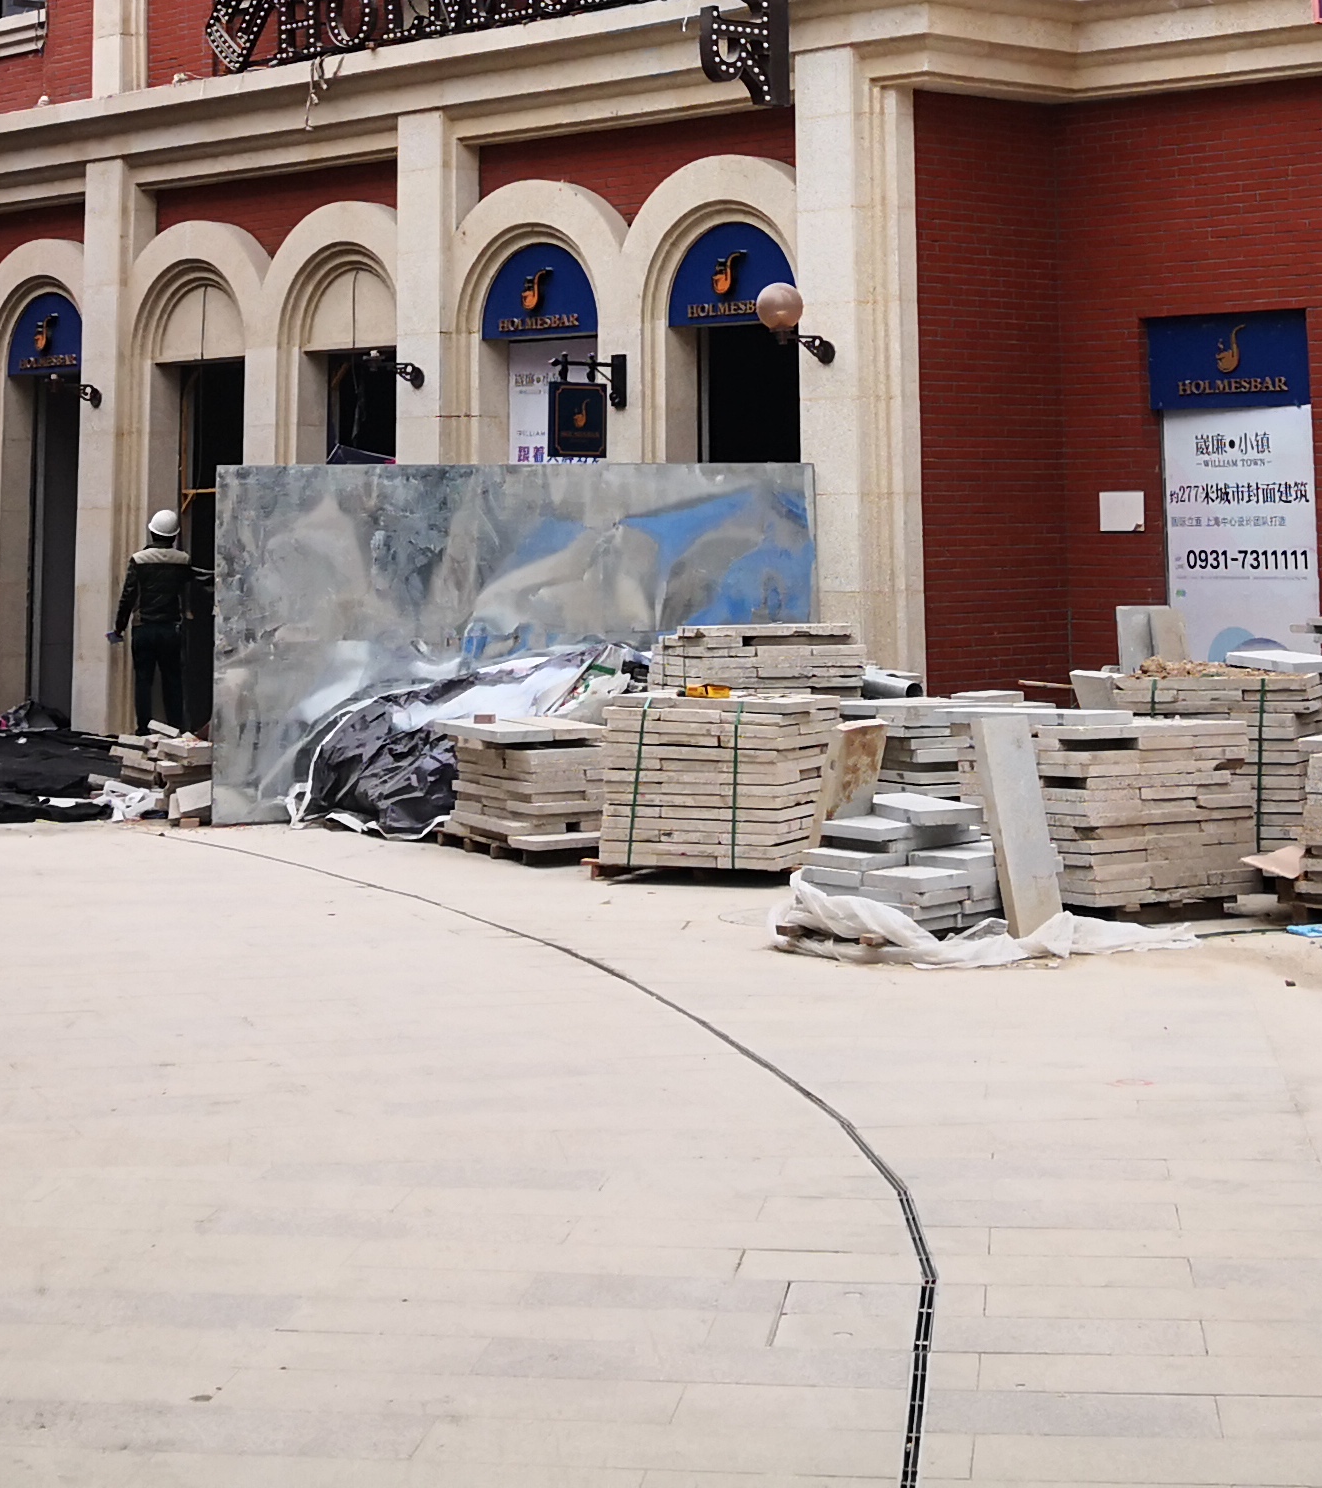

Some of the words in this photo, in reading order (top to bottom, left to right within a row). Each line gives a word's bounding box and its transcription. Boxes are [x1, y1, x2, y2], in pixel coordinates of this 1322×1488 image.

[497, 313, 580, 334] HOLMESBAR
[1177, 376, 1289, 397] HOLMESBAR
[1186, 549, 1309, 570] 0931-7311111
